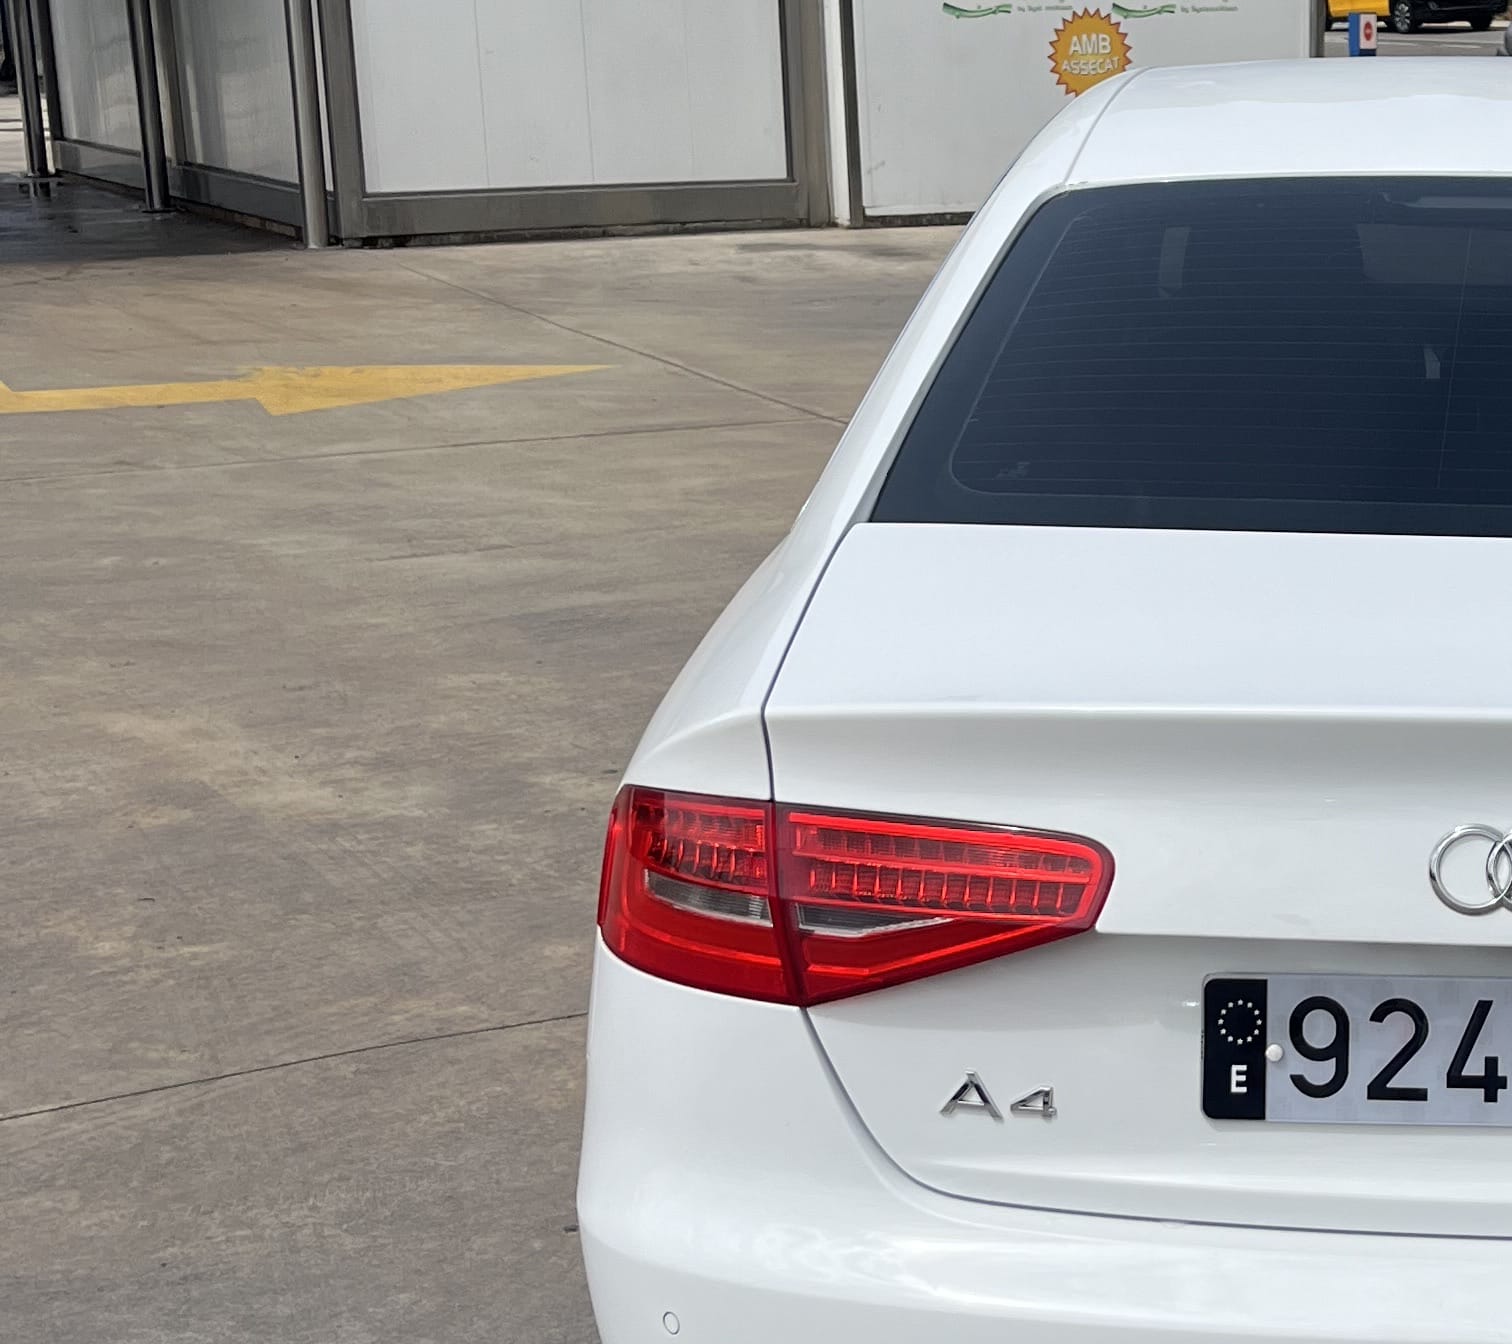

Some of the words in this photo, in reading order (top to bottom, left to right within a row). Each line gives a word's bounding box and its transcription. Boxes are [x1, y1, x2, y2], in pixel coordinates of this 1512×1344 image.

[1069, 32, 1112, 55] AMB
[1062, 56, 1120, 75] ASSECAT
[1231, 1064, 1247, 1093] E
[939, 1070, 1058, 1121] A4
